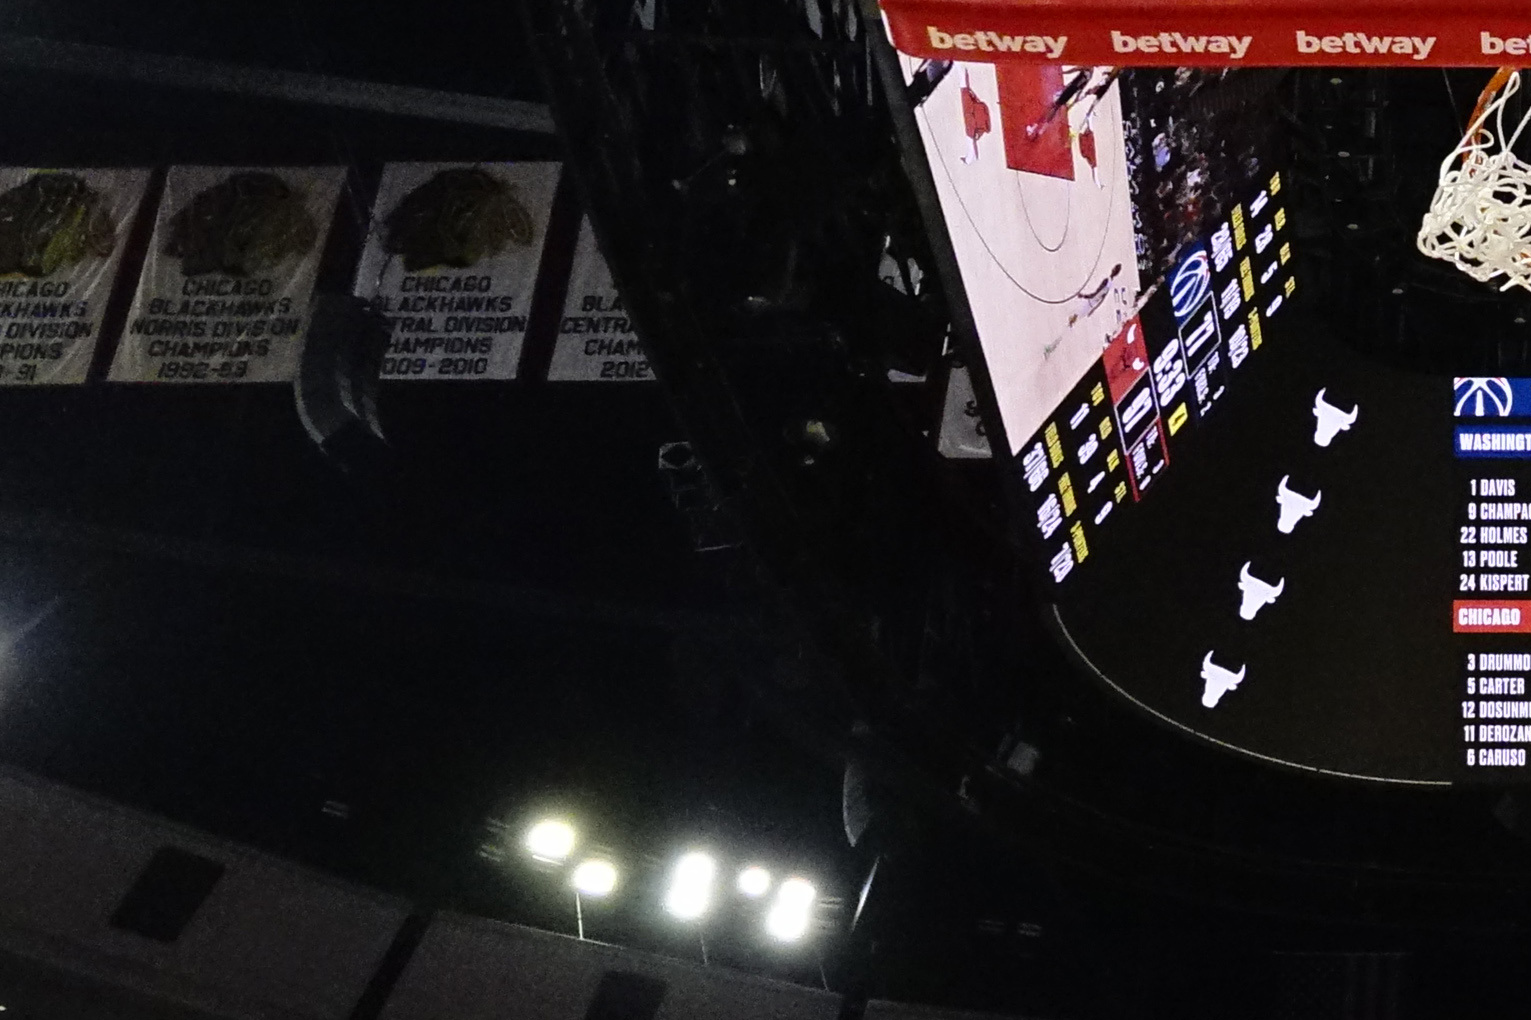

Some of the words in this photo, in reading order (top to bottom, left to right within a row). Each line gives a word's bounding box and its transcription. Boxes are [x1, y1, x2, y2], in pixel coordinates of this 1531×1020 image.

[927, 27, 1068, 58] betway
[1112, 30, 1252, 59] betway
[1296, 30, 1437, 59] betway
[181, 279, 272, 296] CHICAGO
[402, 276, 491, 293] CHICAGO
[445, 315, 526, 333] DIVISION
[1471, 479, 1476, 496] 1
[1480, 479, 1515, 496] DAVIS
[1468, 503, 1476, 520] 9
[1460, 527, 1476, 543] 22
[1480, 527, 1527, 543] HOLMES
[1463, 550, 1476, 567] 13
[1480, 551, 1517, 567] POOLE
[1460, 574, 1476, 591] 24
[1480, 574, 1529, 591] KISPERT
[1459, 609, 1520, 625] CHICAGO
[1468, 654, 1475, 670] 3
[1467, 678, 1475, 694] 5
[1480, 678, 1524, 694] CARTER
[1462, 702, 1475, 718] 12
[1464, 725, 1475, 742] 11
[1479, 725, 1531, 742] DEROZAN
[1467, 749, 1475, 766] 6
[1479, 749, 1525, 766] CARUSO
